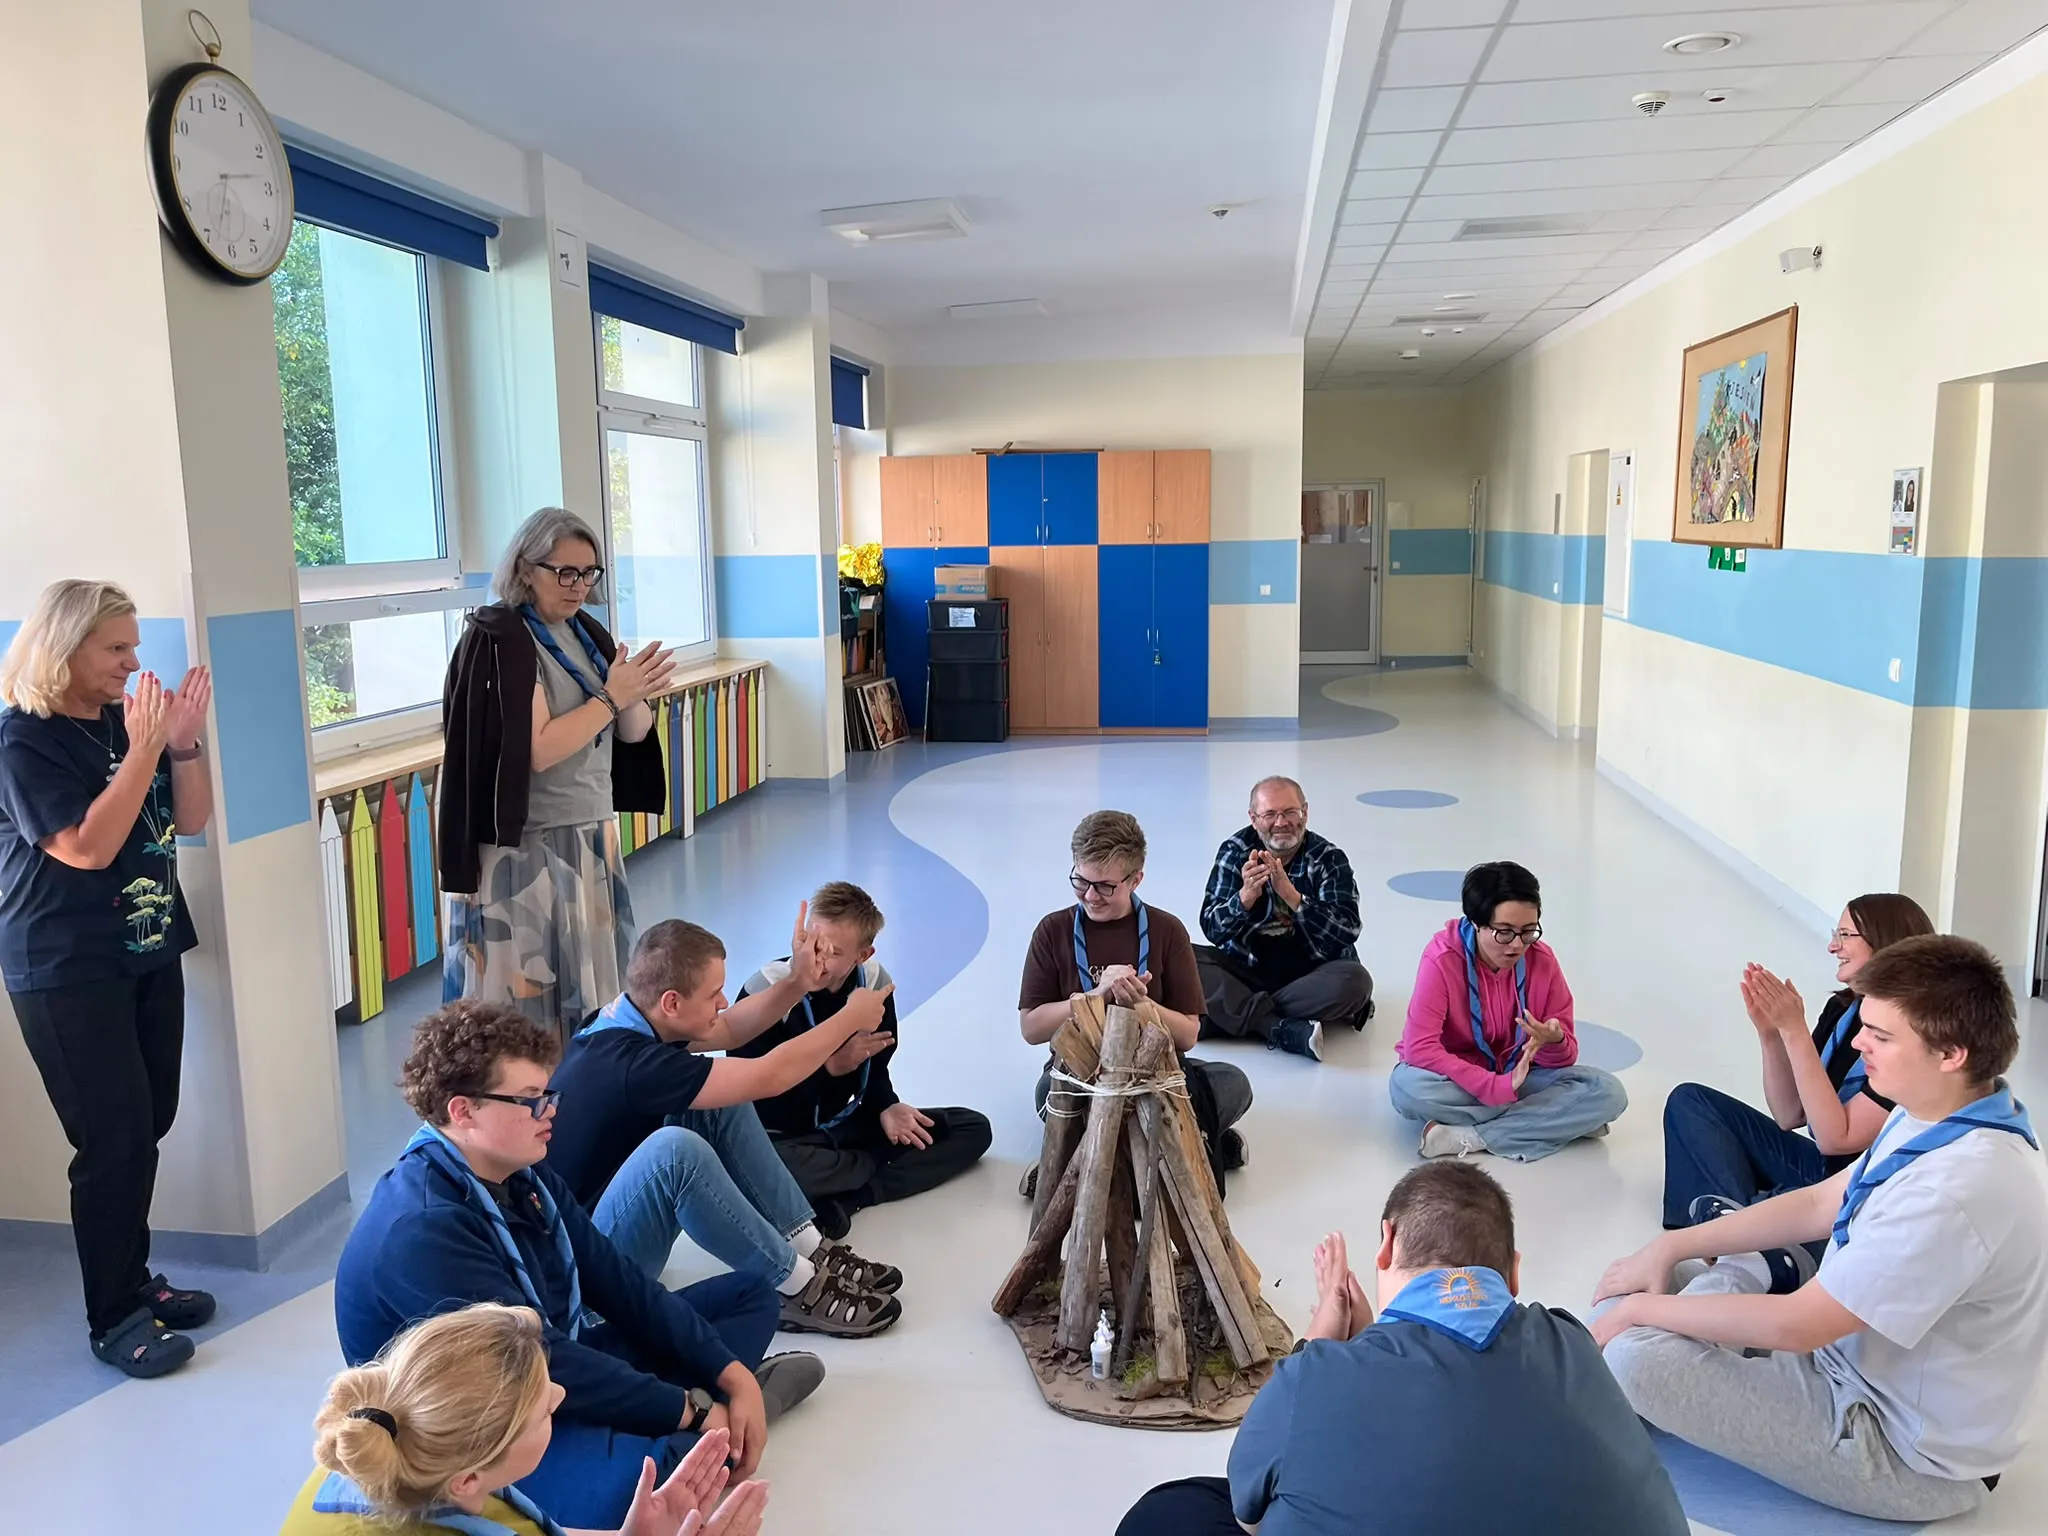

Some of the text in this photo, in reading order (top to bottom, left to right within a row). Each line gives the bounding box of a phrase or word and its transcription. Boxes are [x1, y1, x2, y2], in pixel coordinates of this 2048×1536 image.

[189, 95, 203, 114] 11
[212, 93, 226, 111] 12
[238, 112, 244, 127] 1
[255, 144, 263, 159] 2
[264, 181, 273, 196] 3
[263, 217, 271, 231] 4
[203, 228, 210, 244] 7
[228, 245, 236, 259] 6
[249, 239, 258, 253] 5
